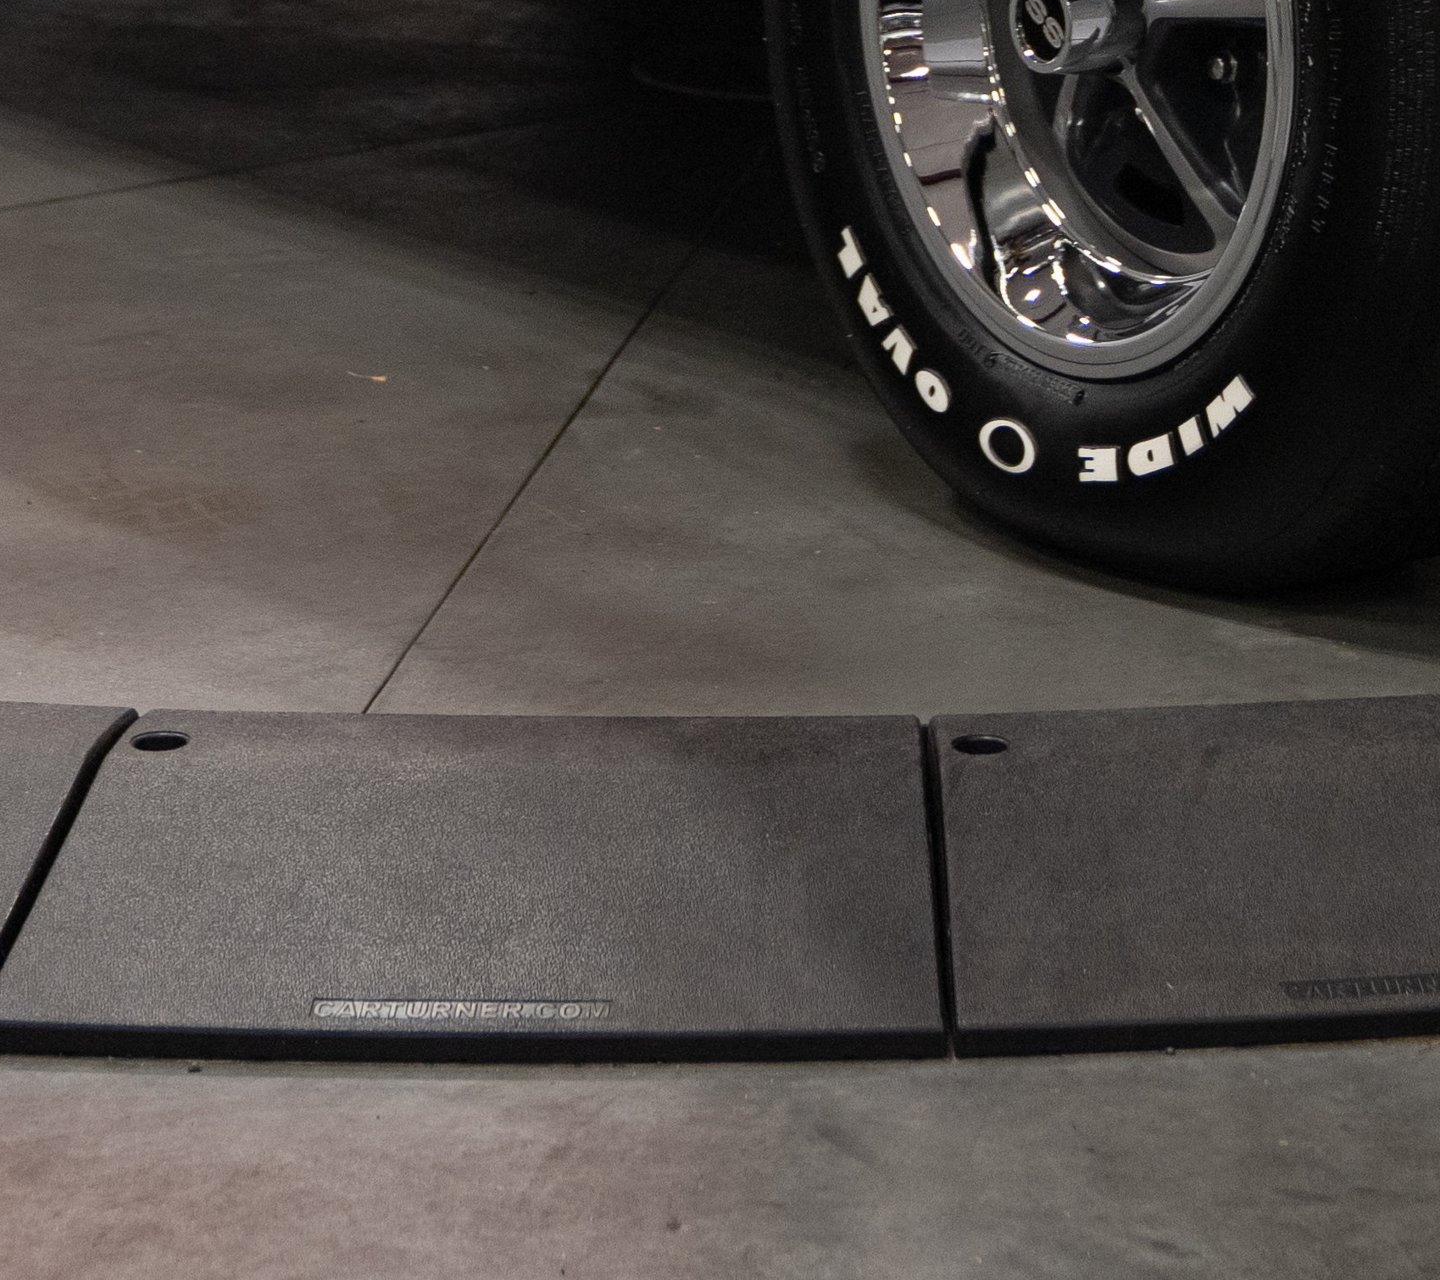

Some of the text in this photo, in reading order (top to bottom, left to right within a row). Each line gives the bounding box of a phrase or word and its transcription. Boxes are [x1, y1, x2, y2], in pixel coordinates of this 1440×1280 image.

[837, 226, 951, 414] OVAL
[1078, 374, 1256, 482] WIDE
[313, 1000, 610, 1020] CARTURNER.COM
